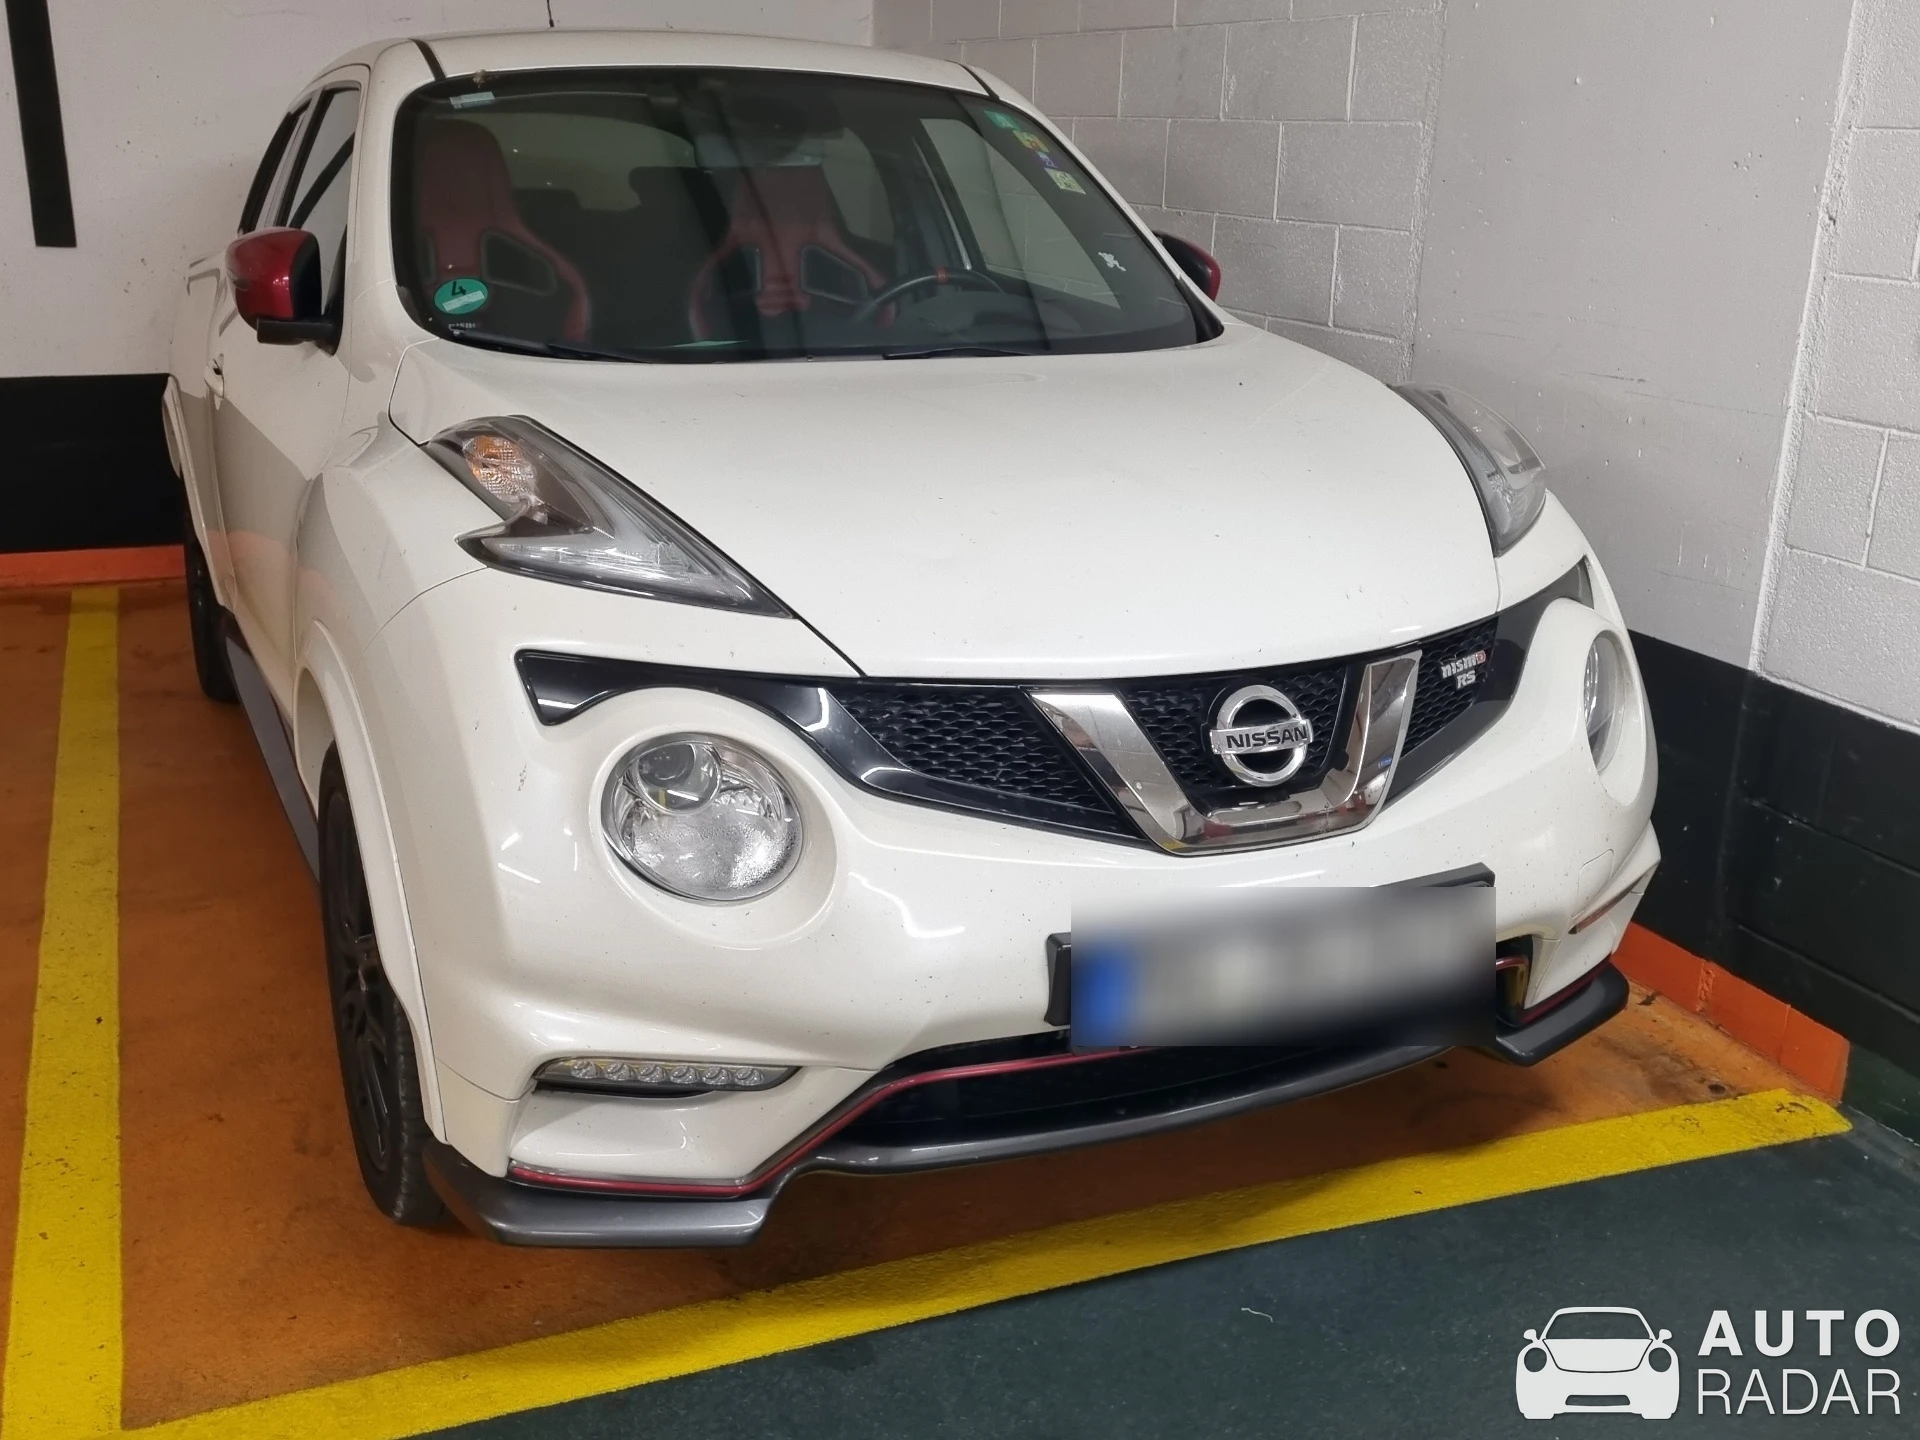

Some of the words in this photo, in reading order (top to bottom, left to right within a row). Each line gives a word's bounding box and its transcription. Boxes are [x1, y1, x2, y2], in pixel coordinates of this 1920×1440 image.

[451, 281, 467, 296] 4
[1456, 669, 1476, 690] RS
[1226, 726, 1307, 749] NISSAN
